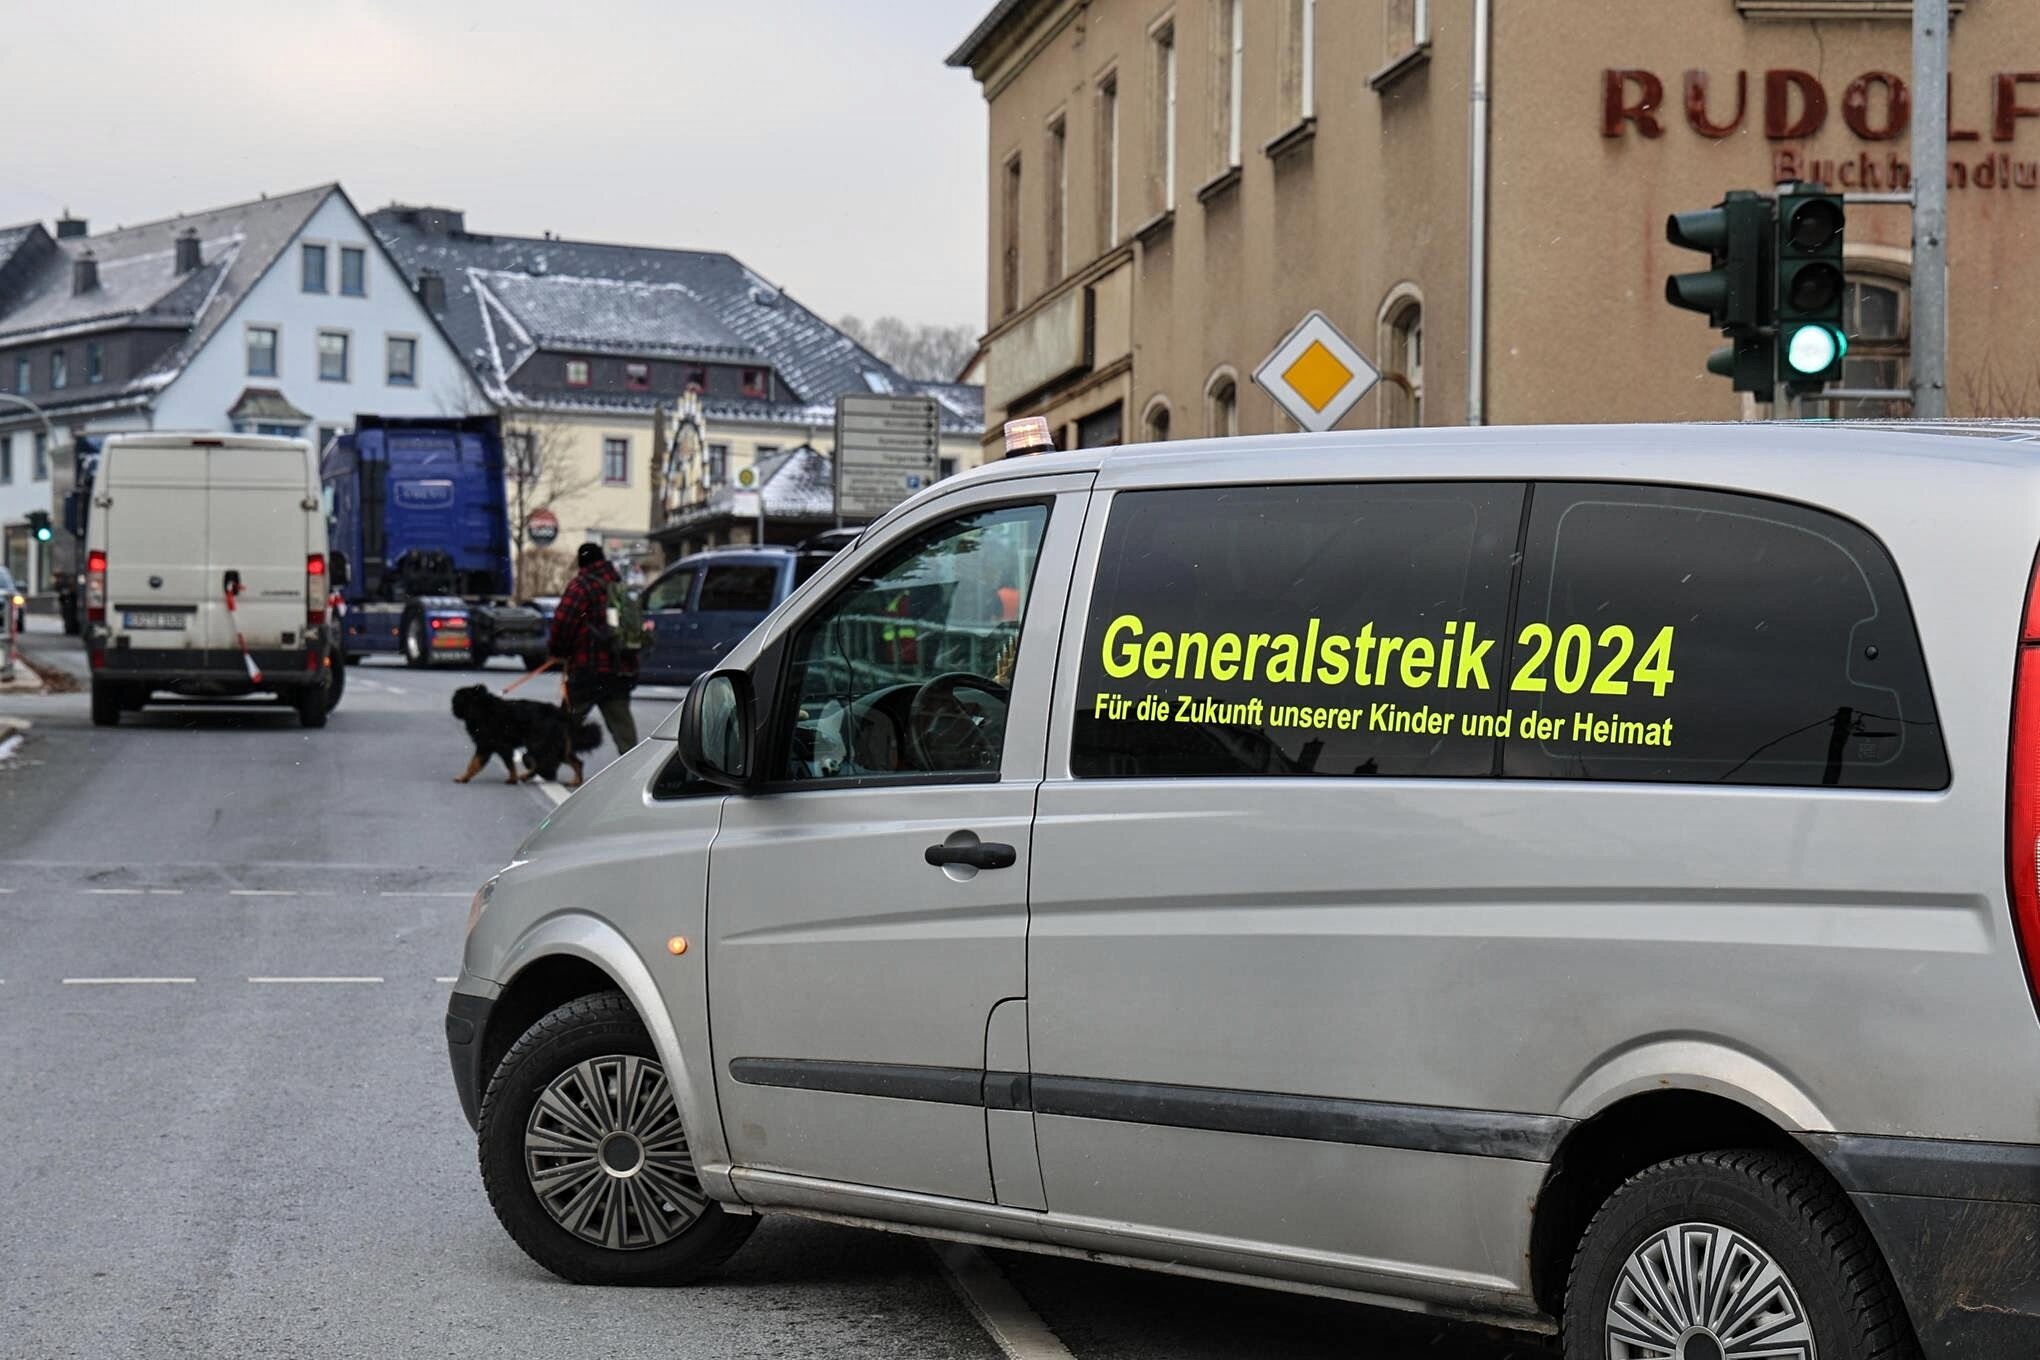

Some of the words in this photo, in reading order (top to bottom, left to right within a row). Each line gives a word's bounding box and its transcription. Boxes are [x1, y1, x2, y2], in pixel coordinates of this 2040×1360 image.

[1774, 150, 2039, 190] Buchhndlu
[1102, 615, 1495, 691] Generalstreik
[1511, 623, 1676, 698] 2024
[1094, 693, 1133, 722] Für
[1136, 695, 1171, 723] die
[1175, 696, 1265, 728] Zukunft
[1269, 707, 1364, 732] unserer
[1369, 704, 1457, 736] Kinder
[1461, 710, 1514, 739] und
[1519, 712, 1567, 742] der
[1572, 714, 1675, 748] Heimat
